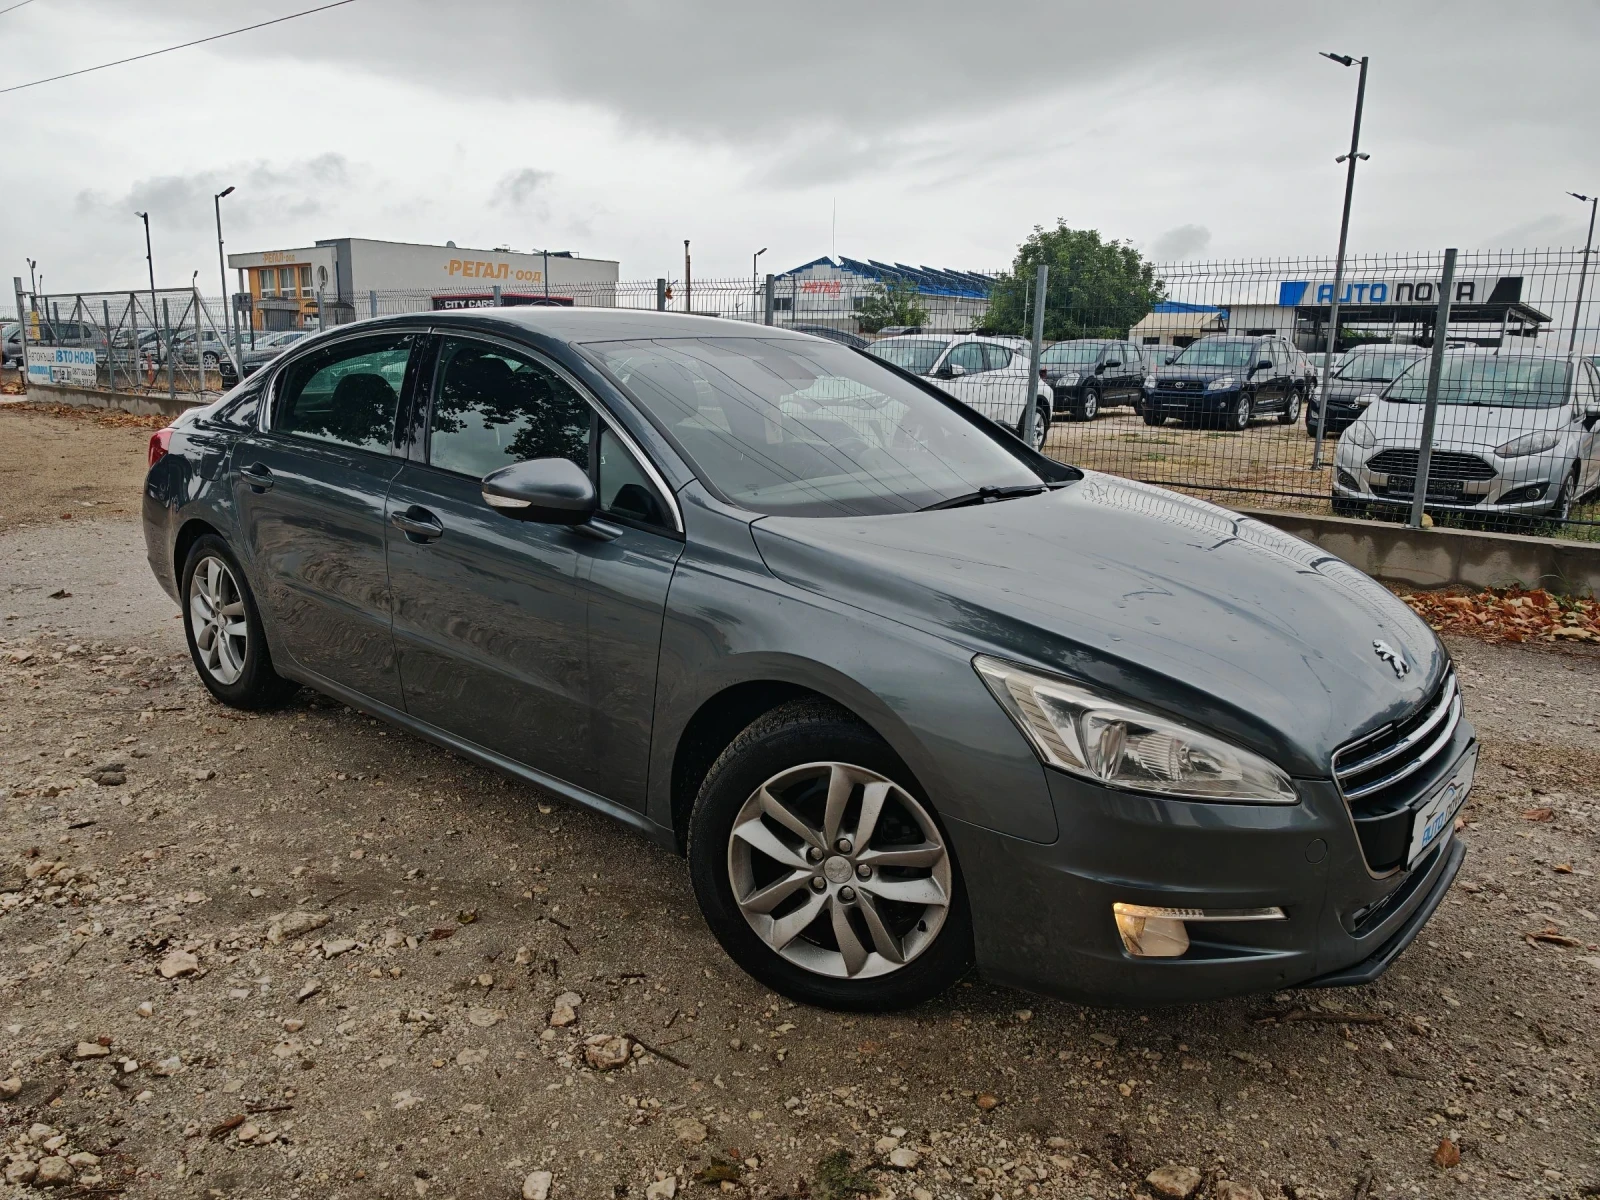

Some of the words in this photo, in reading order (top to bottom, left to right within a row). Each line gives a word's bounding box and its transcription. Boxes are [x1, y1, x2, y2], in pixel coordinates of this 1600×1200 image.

[449, 259, 510, 280] РЕГАЛ
[1317, 282, 1389, 303] AUTO
[444, 300, 467, 309] CITY
[468, 299, 495, 308] CARS
[74, 351, 96, 365] НОВА
[1421, 811, 1445, 847] AUTO
